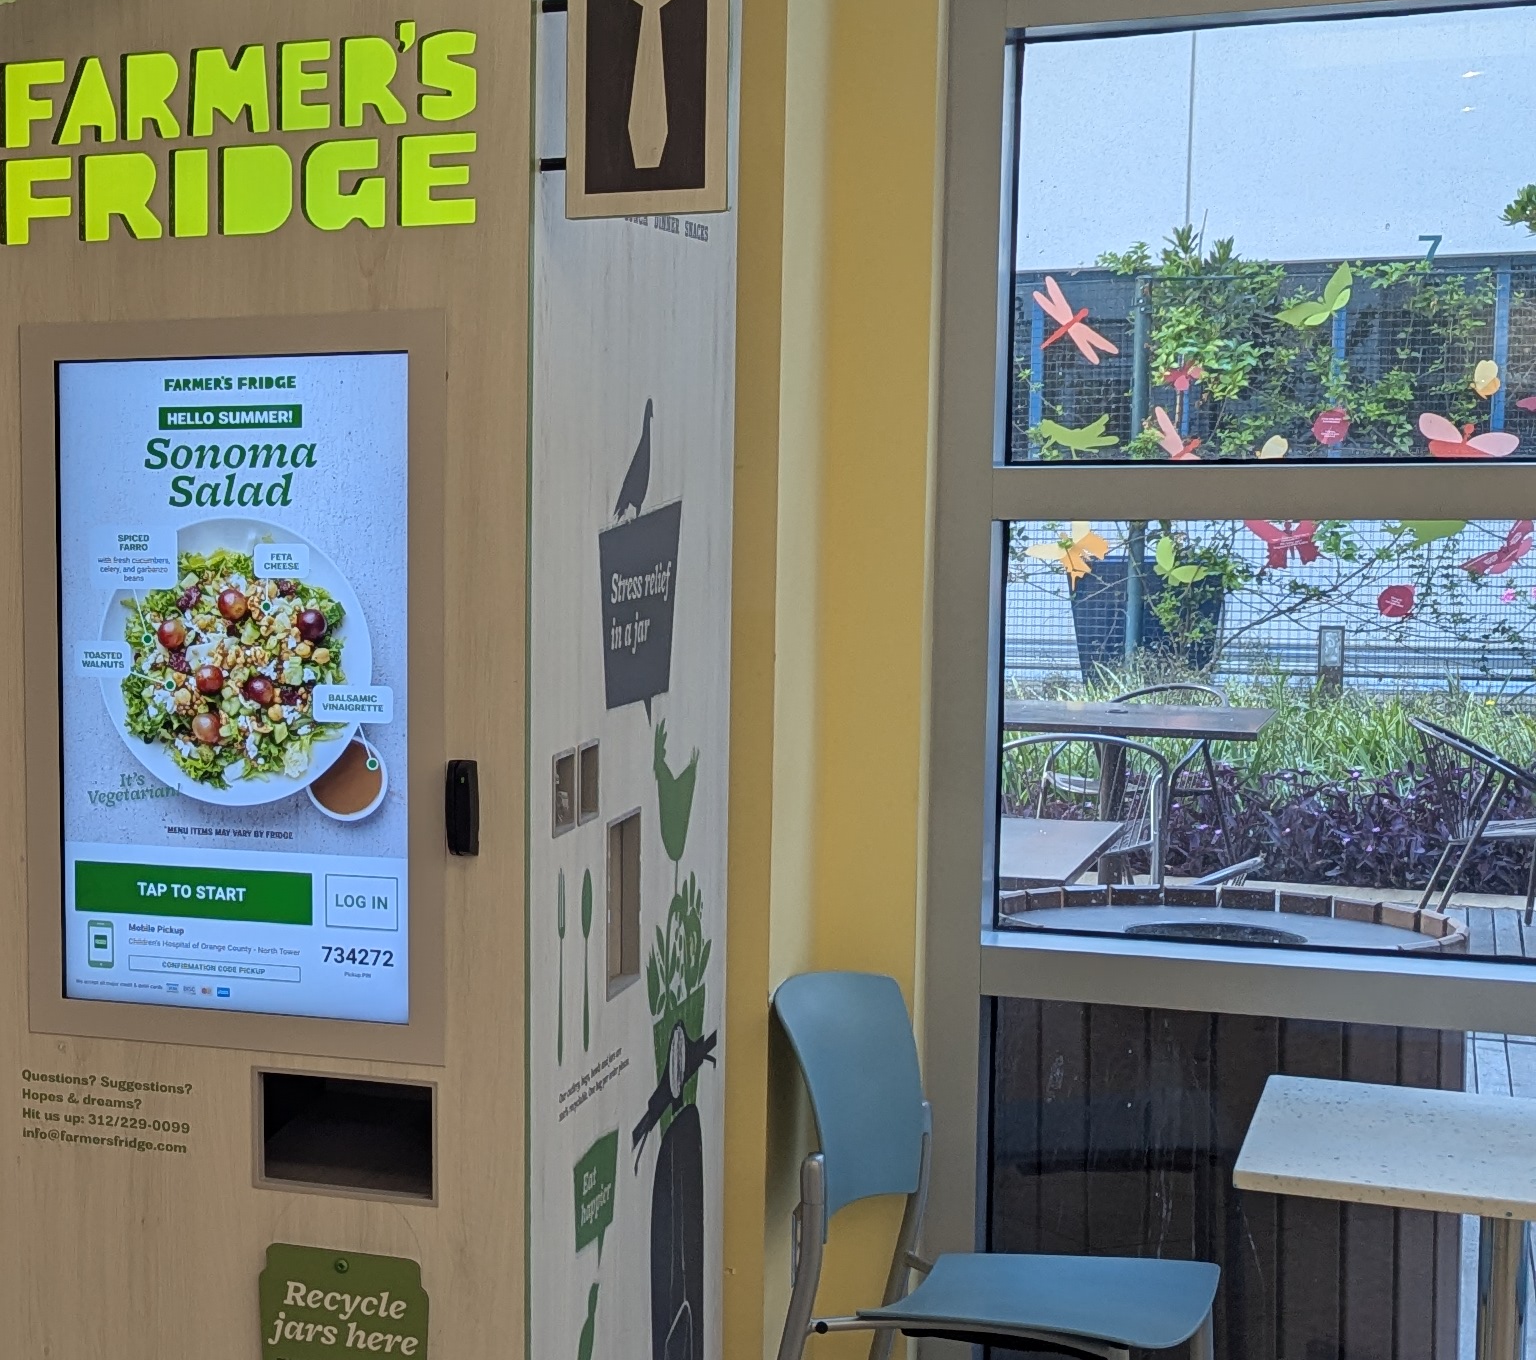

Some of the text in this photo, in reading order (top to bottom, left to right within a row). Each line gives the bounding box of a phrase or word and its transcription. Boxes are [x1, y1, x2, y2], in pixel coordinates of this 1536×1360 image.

[0, 23, 477, 148] FARMER'S
[0, 133, 476, 245] FRIDGE
[684, 221, 709, 242] SNACKS
[164, 375, 297, 392] FARMER'S FRIDGE
[167, 410, 293, 425] HELLO SUMMER!
[144, 437, 317, 470] Sonoma
[168, 472, 293, 508] Salad
[118, 534, 150, 542] SPICED
[119, 543, 148, 551] FARRO
[264, 562, 300, 570] CHEESE
[270, 553, 293, 561] FETA
[610, 561, 671, 605] Stress relief
[610, 612, 651, 655] in a jar
[82, 659, 125, 669] WALNUTS
[83, 651, 123, 660] TOASTED
[322, 702, 384, 712] VINAIGRETTE
[328, 694, 377, 703] BALSAMIC
[119, 773, 145, 788] It's
[87, 784, 181, 808] Vegetarian!
[191, 826, 213, 836] ITEMS
[215, 828, 231, 837] MAY
[233, 828, 252, 837] VARY
[254, 830, 264, 838] BY
[266, 831, 294, 840] FRIDGE
[137, 881, 246, 902] TAP TO START
[335, 894, 388, 909] LOG IN
[128, 923, 185, 936] Mobile Pickup
[128, 938, 161, 947] Children's
[163, 940, 190, 949] Hospital
[201, 943, 226, 952] Orange
[227, 944, 252, 954] County
[258, 946, 278, 954] North
[280, 948, 301, 956] Tower
[321, 946, 394, 967] 734272
[162, 961, 265, 975] CONFIRMATION CODE PICKUP
[22, 1069, 193, 1095] Questions? Suggestions?
[22, 1088, 142, 1110] Hopes & dreams?
[22, 1108, 191, 1134] Hit us up: 312/229-0099
[22, 1127, 187, 1154] info@farmersfridge.com
[582, 1166, 597, 1196] Eat
[283, 1280, 407, 1320] Recycle
[268, 1312, 419, 1356] jars here
